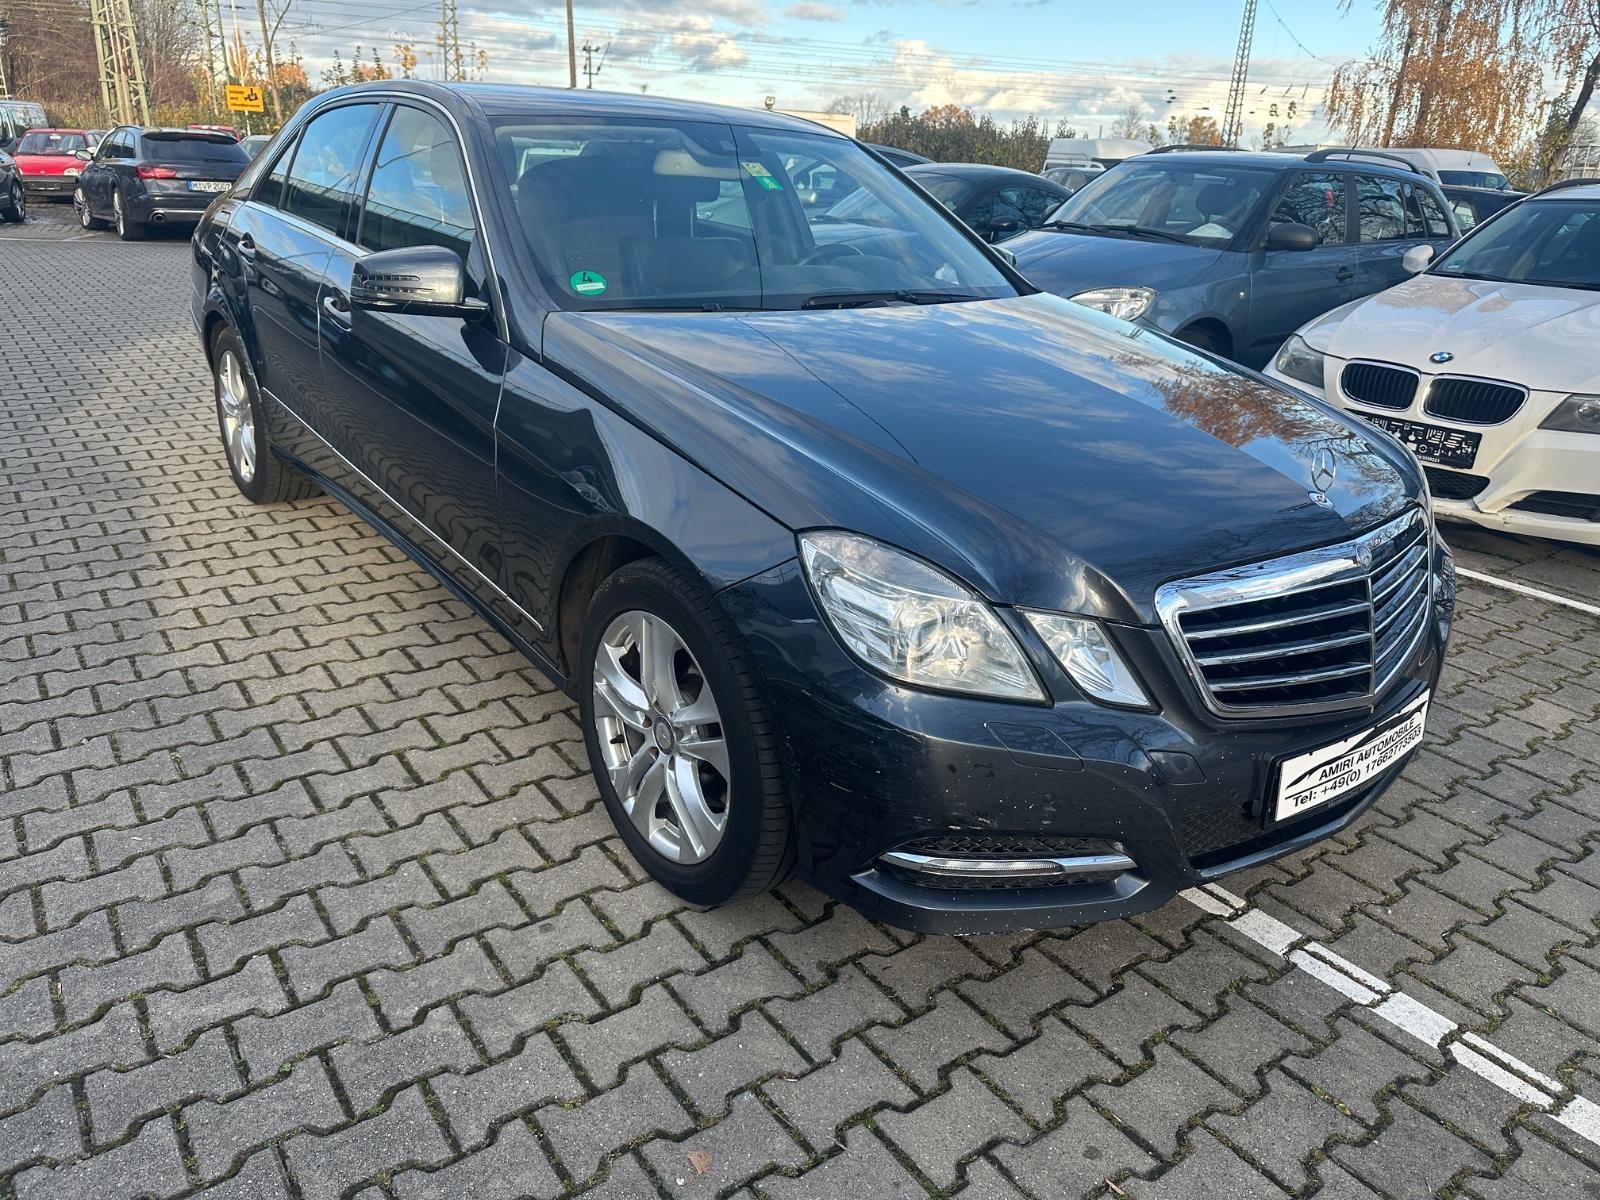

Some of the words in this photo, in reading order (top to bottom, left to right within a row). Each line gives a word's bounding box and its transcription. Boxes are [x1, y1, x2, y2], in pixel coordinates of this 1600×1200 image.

[582, 271, 593, 283] 4
[1319, 756, 1354, 781] AMIRI
[1356, 718, 1415, 764] AUTOMOBILE
[1293, 790, 1317, 807] Tel:
[1320, 769, 1361, 795] +49(0)
